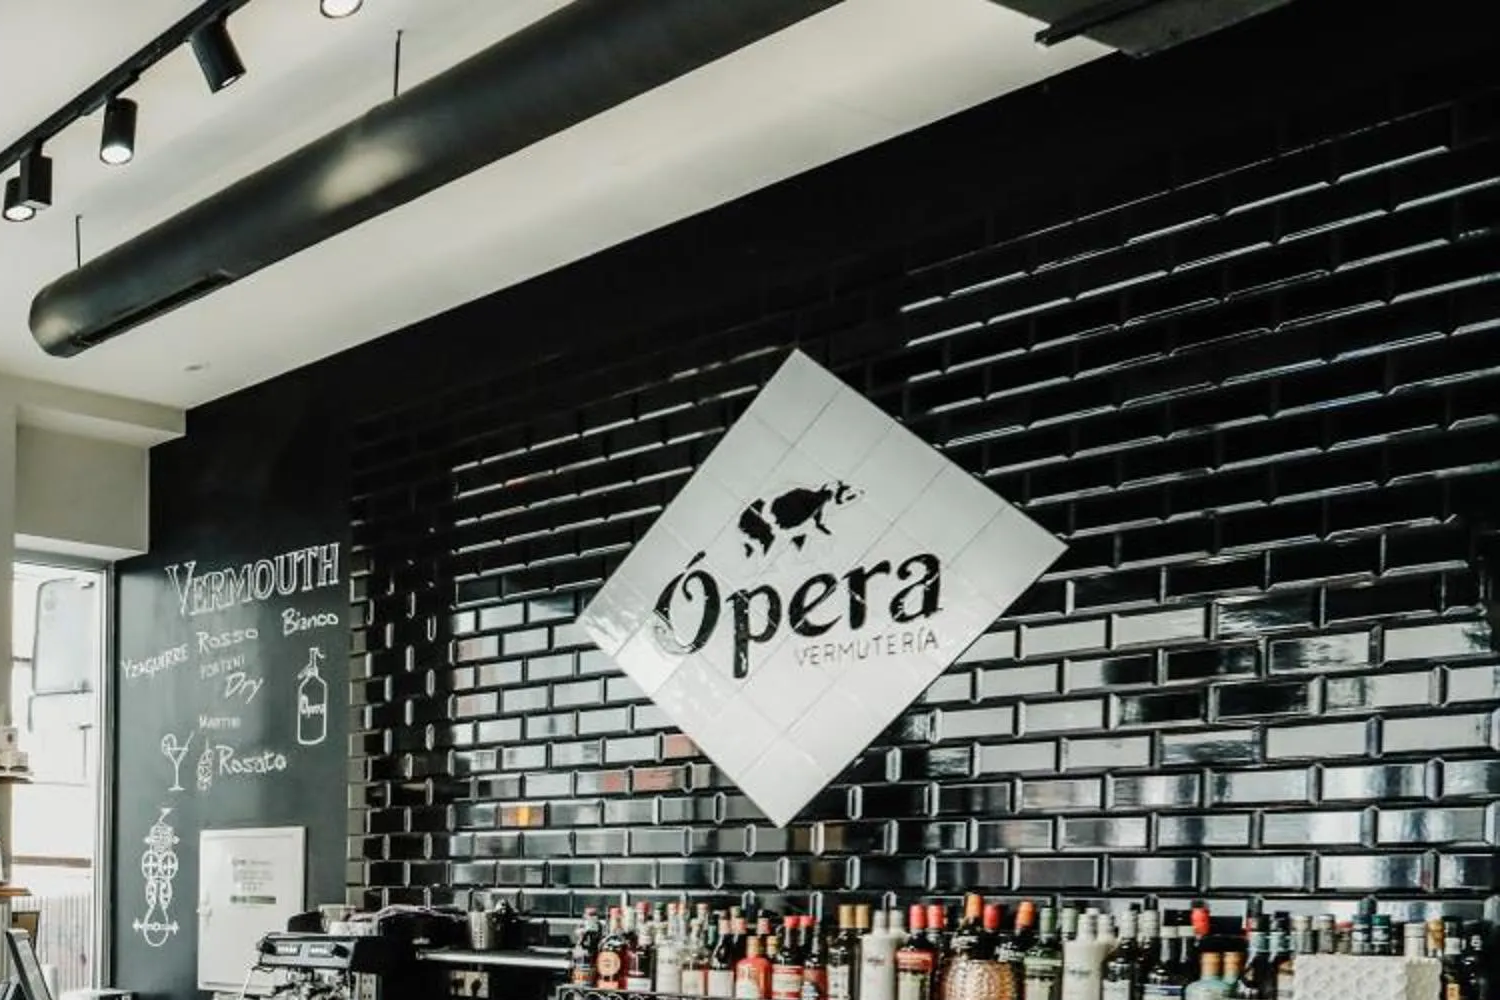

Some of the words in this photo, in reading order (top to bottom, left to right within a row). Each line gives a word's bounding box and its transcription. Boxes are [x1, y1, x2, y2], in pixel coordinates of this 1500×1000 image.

[164, 542, 340, 617] VERMOUTH
[652, 551, 944, 680] Ópera
[196, 627, 259, 654] Rosso
[795, 626, 940, 667] VERMUTERÍA
[225, 671, 264, 704] Dry
[215, 744, 287, 776] Rosato
